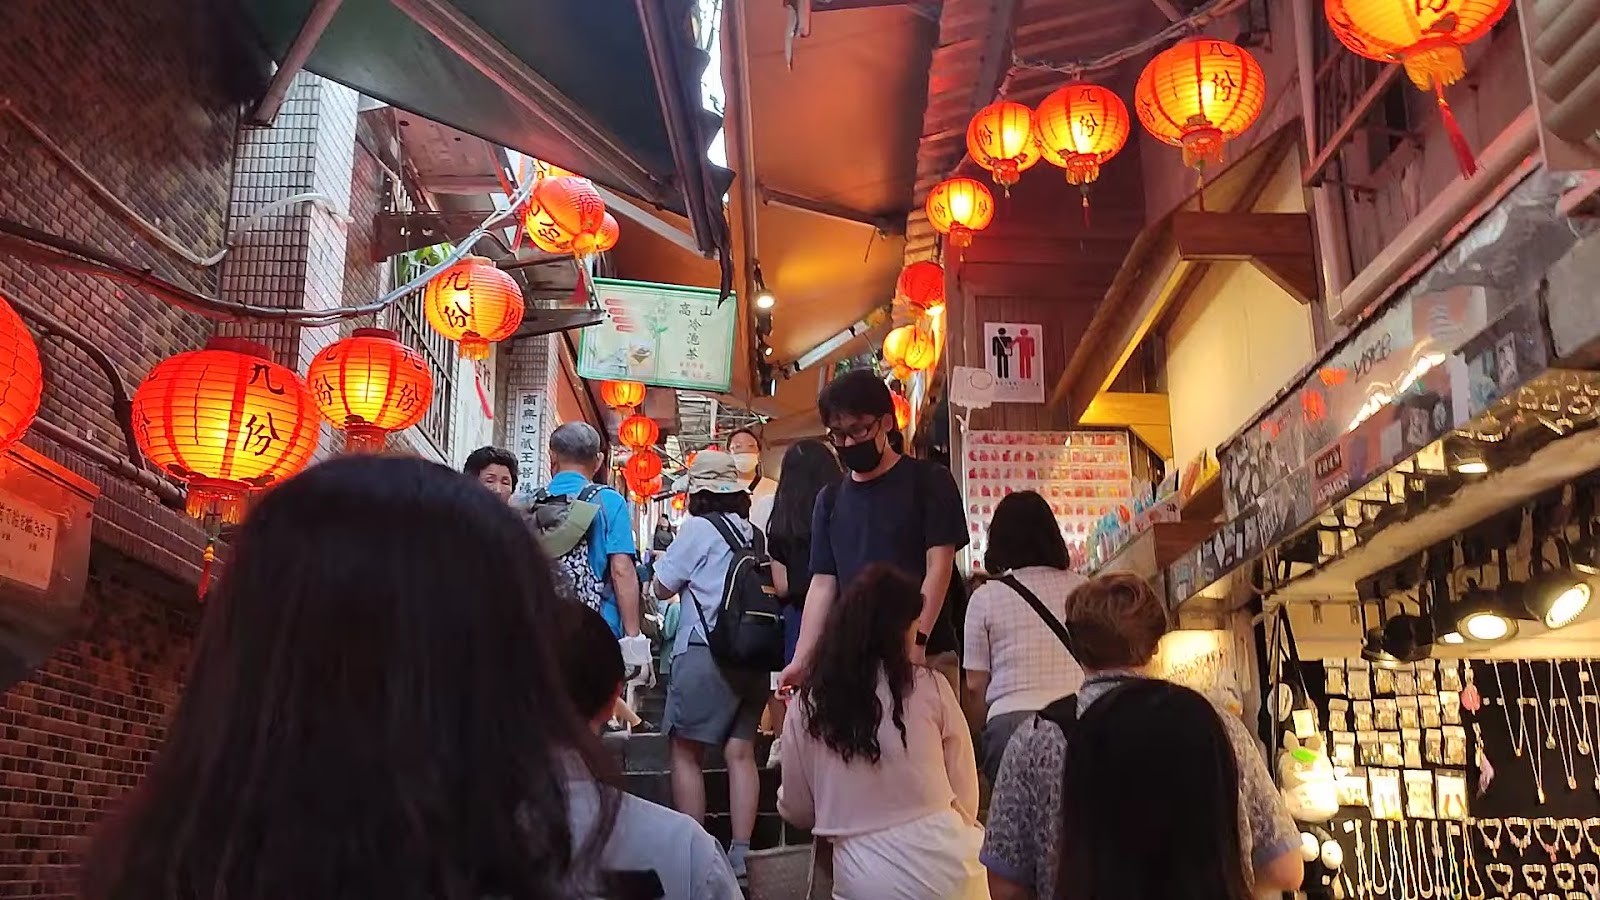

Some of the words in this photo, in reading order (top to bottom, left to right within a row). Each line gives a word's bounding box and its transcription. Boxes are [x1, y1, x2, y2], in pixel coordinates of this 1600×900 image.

[1209, 42, 1236, 102] 九份
[1079, 88, 1098, 137] 九份
[442, 270, 471, 329] 九份
[241, 363, 285, 457] 九份
